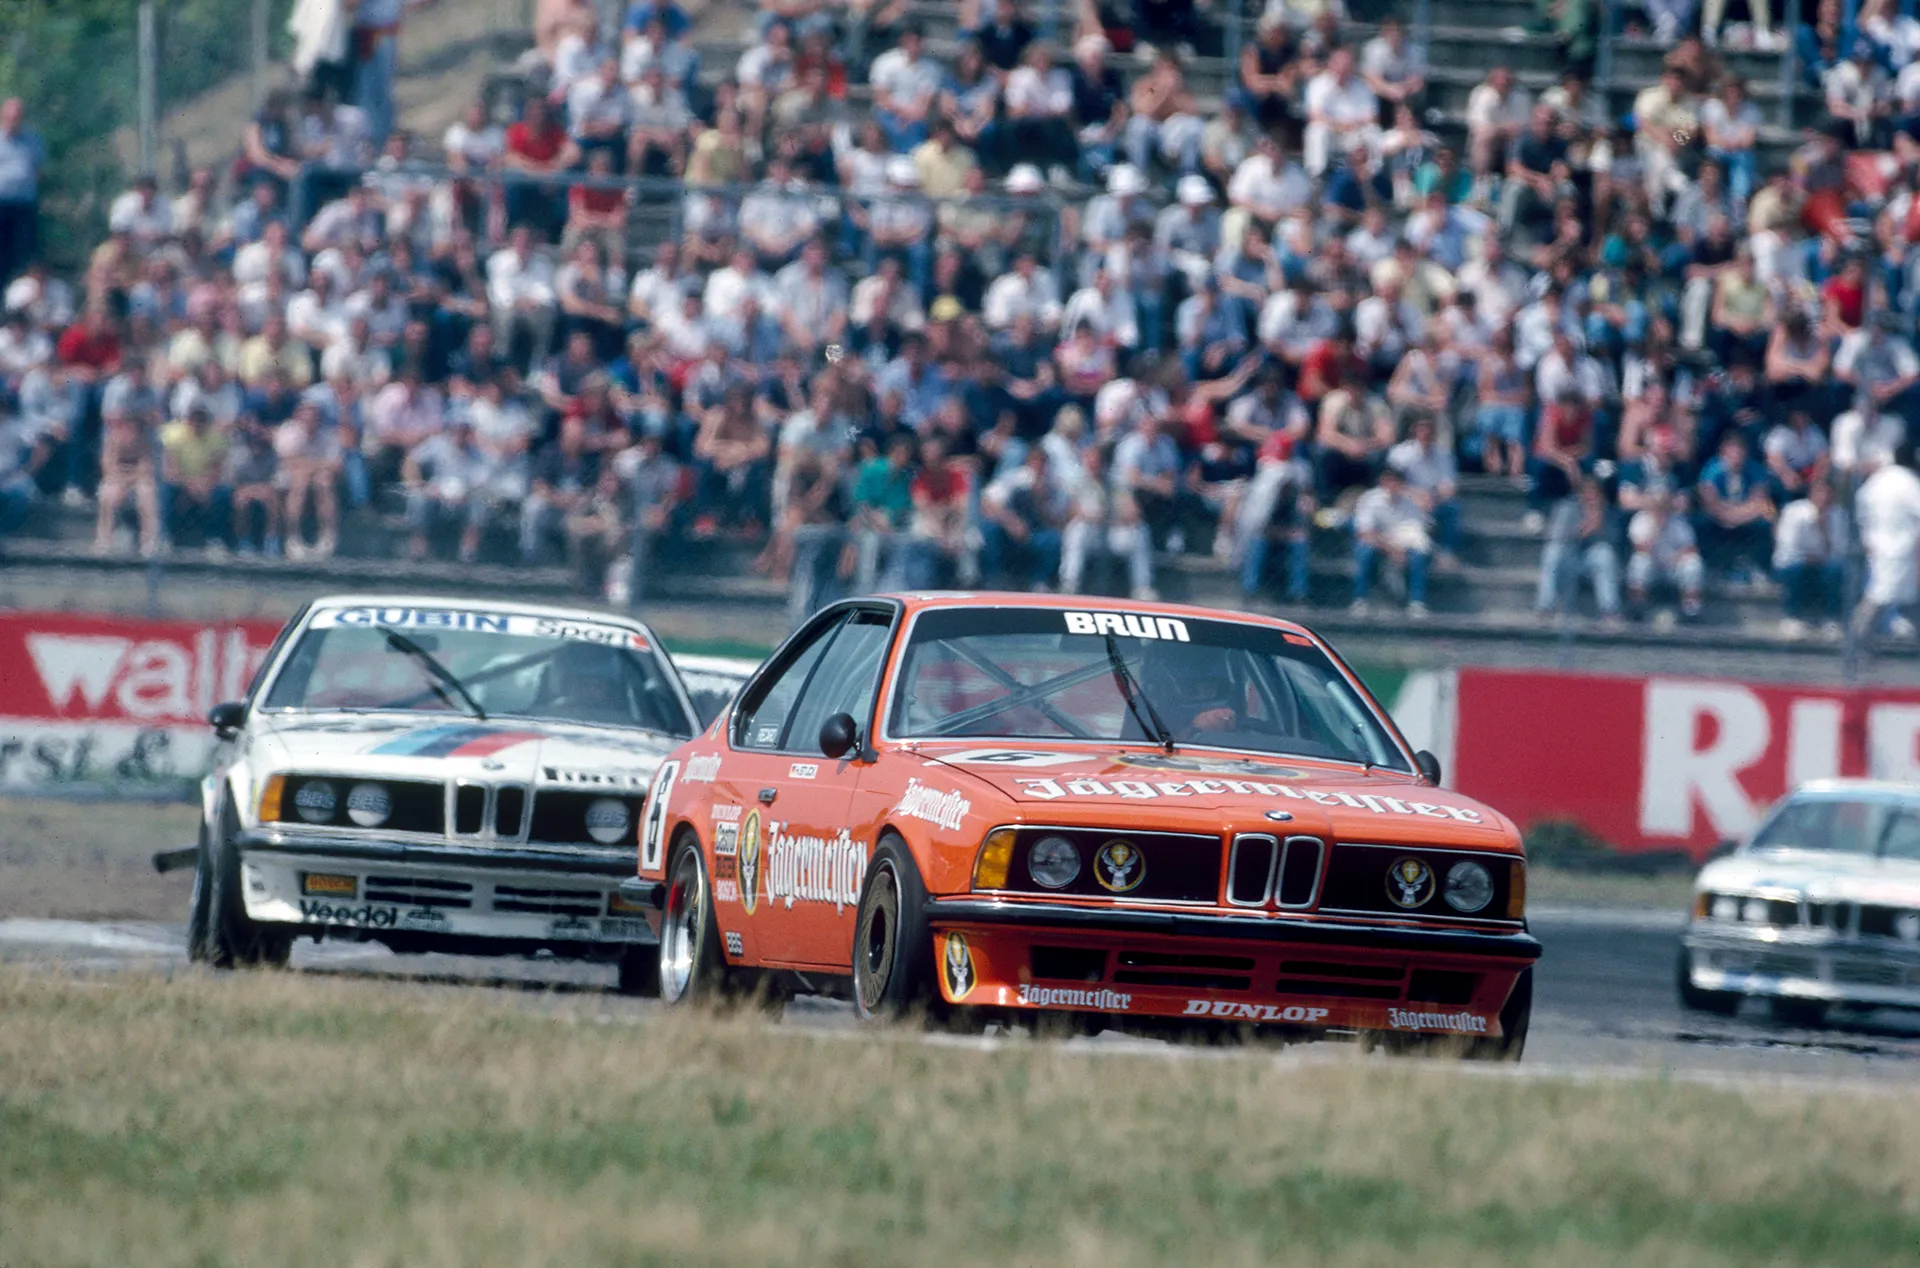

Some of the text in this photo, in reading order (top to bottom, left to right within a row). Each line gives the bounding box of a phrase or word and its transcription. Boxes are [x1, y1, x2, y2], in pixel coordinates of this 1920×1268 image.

[1063, 612, 1191, 642] BRUN
[966, 751, 1056, 762] 6
[299, 899, 397, 926] Veedol
[1183, 999, 1328, 1022] DUNLOP
